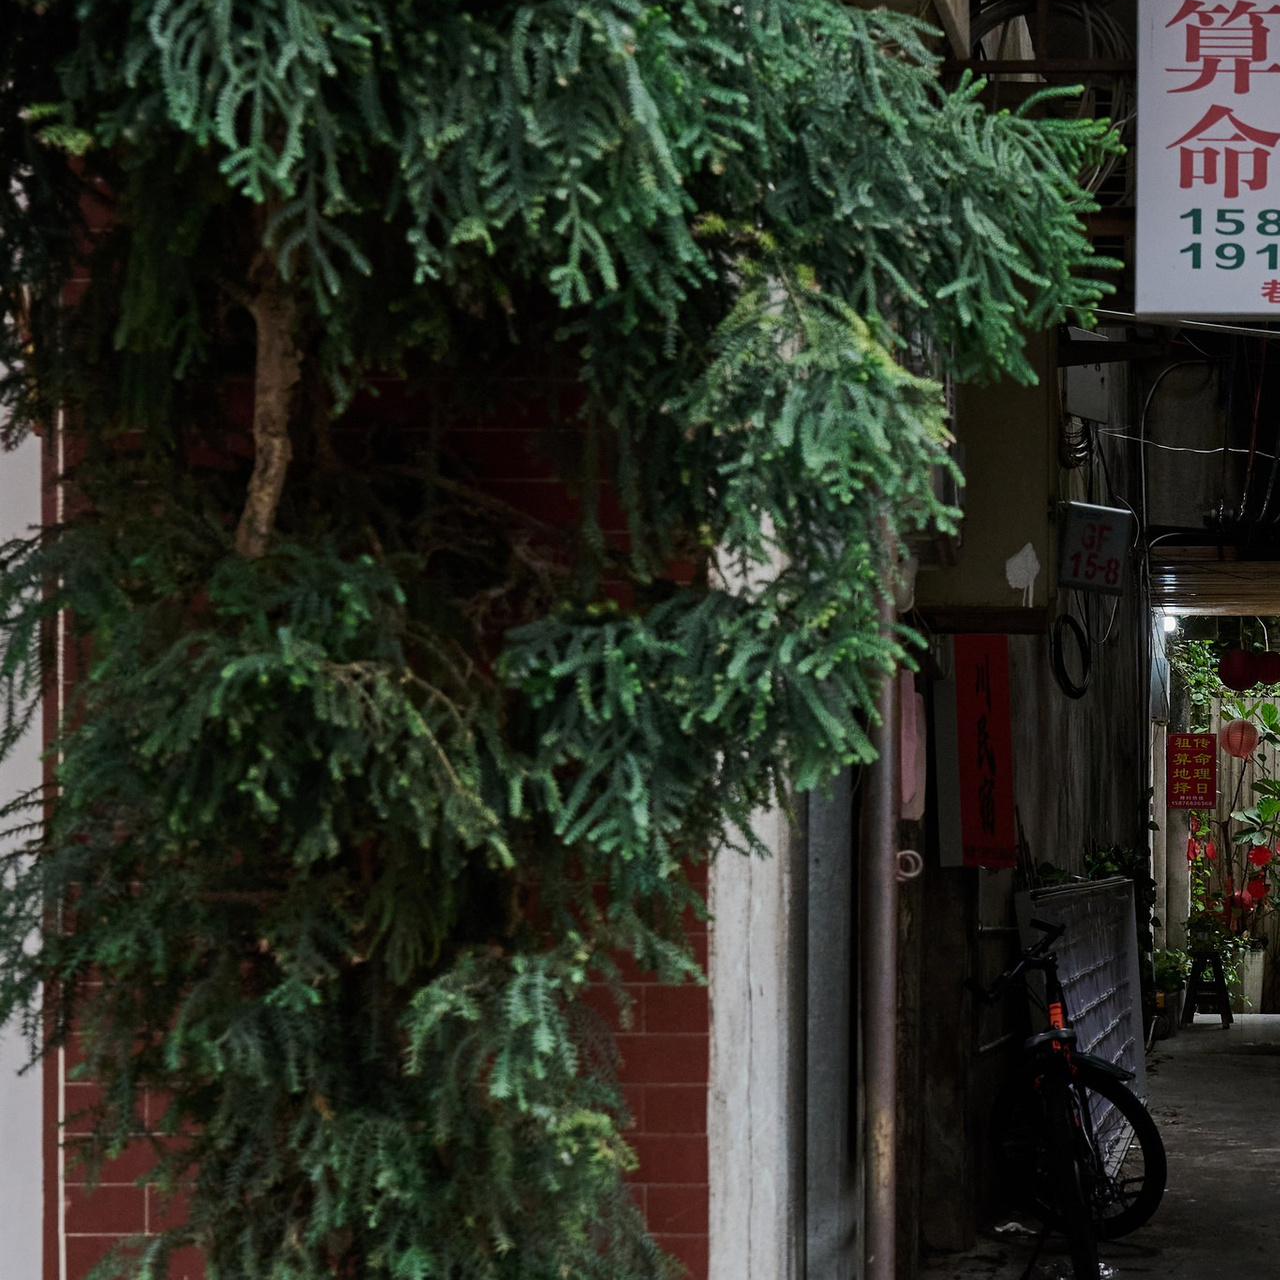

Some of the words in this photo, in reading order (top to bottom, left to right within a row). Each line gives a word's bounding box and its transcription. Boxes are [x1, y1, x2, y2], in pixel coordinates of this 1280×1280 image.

[1070, 551, 1120, 585] 15-8
[1173, 753, 1212, 765] 算命
[1173, 768, 1211, 780] 地理
[1173, 782, 1208, 794] 择日
